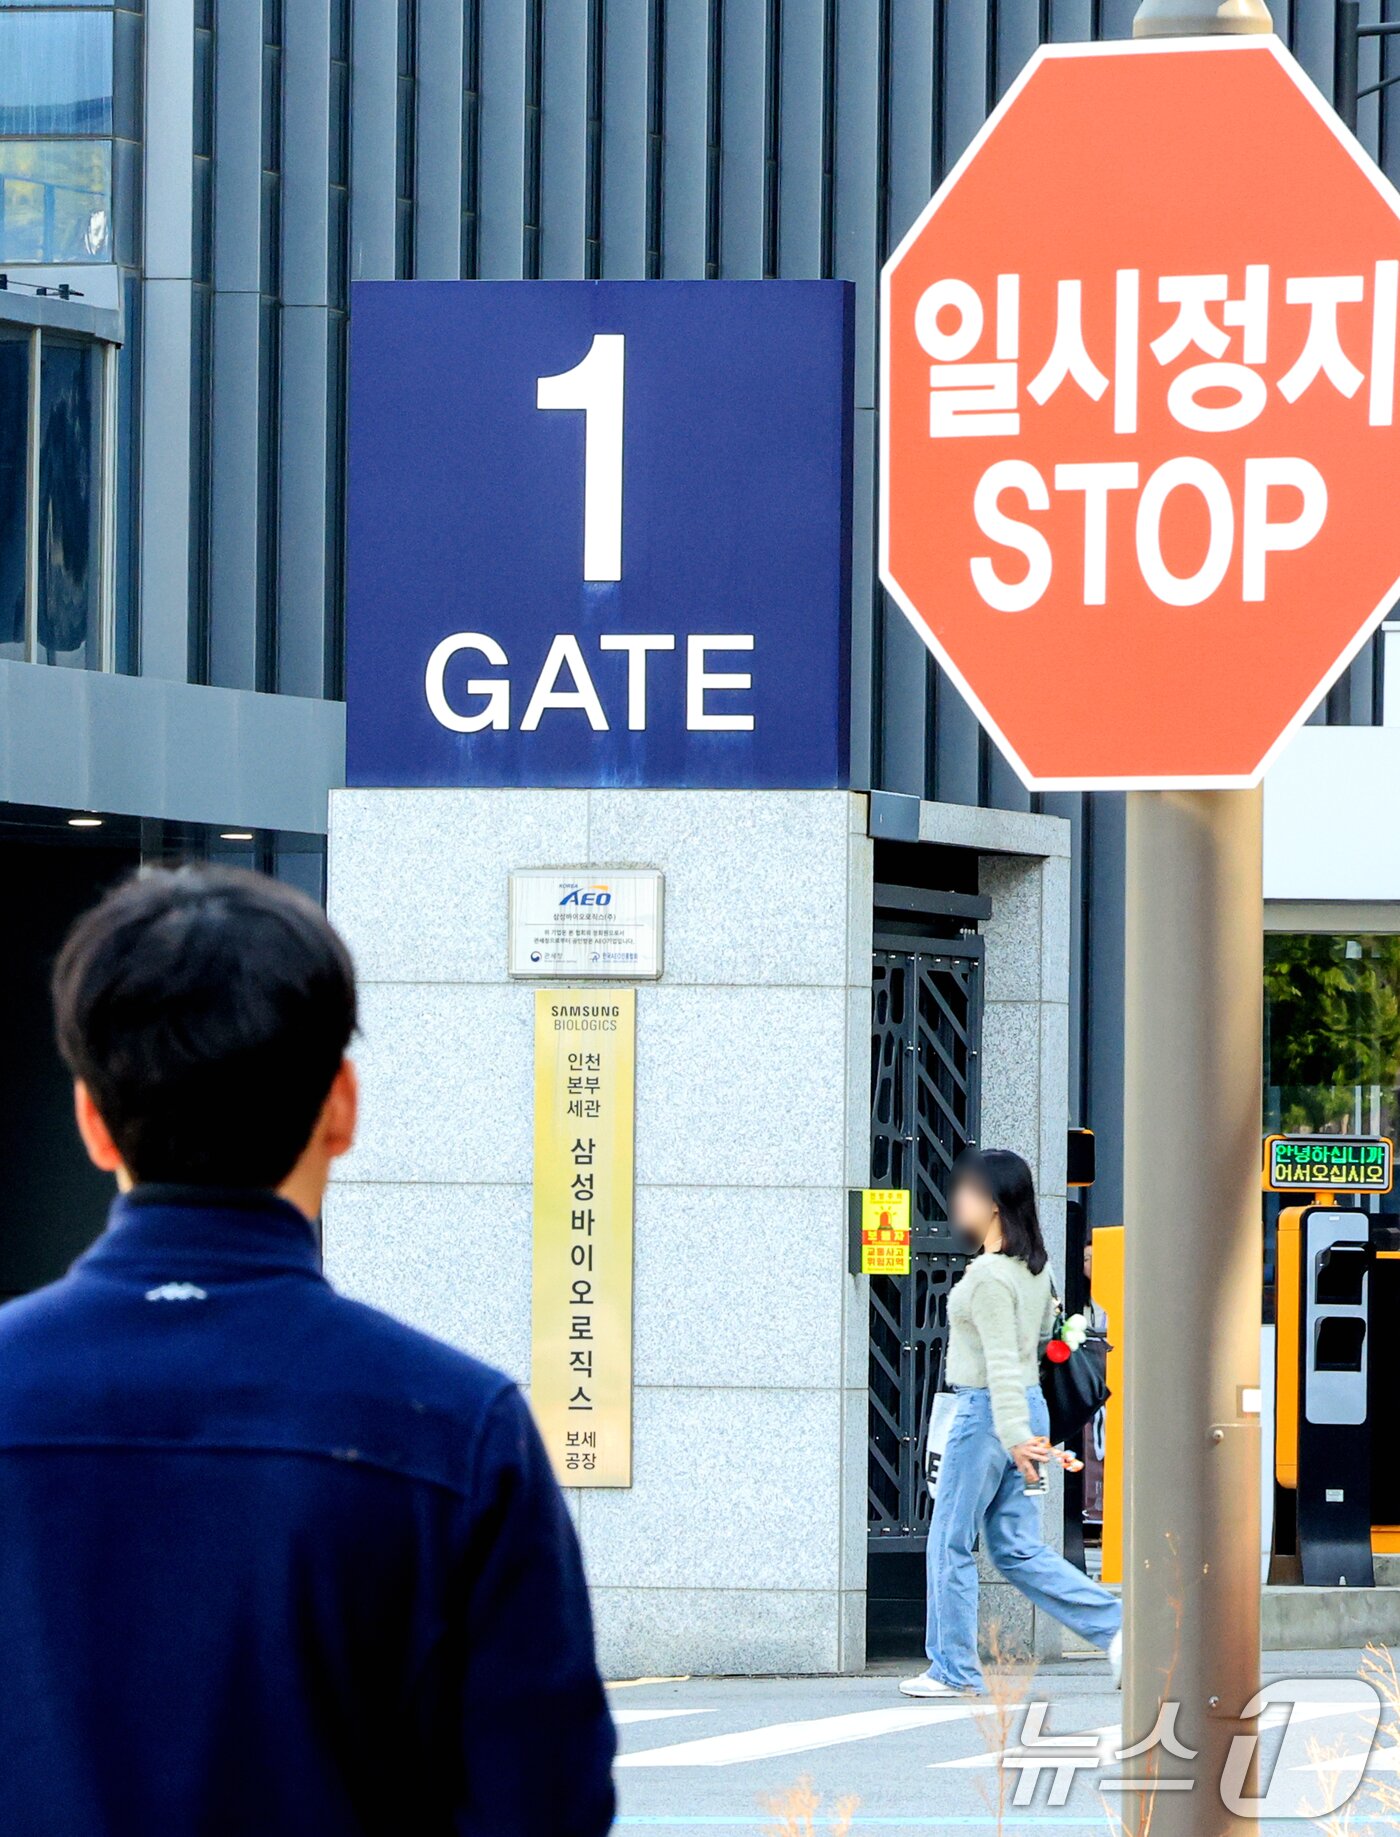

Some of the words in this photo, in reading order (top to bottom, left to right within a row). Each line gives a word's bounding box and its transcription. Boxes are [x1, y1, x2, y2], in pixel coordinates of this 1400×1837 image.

[914, 260, 1399, 437] 일시정지
[537, 334, 624, 581] 1
[970, 456, 1328, 613] STOP
[425, 632, 754, 732] GATE
[558, 888, 611, 906] AEO
[551, 1005, 620, 1017] SAMSUNG
[554, 1019, 617, 1032] BIOLOGICS
[567, 1053, 600, 1071] 인천
[567, 1076, 600, 1094] 본부
[566, 1100, 600, 1118] 세관
[1275, 1144, 1385, 1164] 안녕하십니까
[1275, 1164, 1384, 1183] 어서오십시오
[568, 1138, 596, 1411] 삼성바이오로직스
[565, 1431, 597, 1448] 보세
[565, 1452, 597, 1470] 공장
